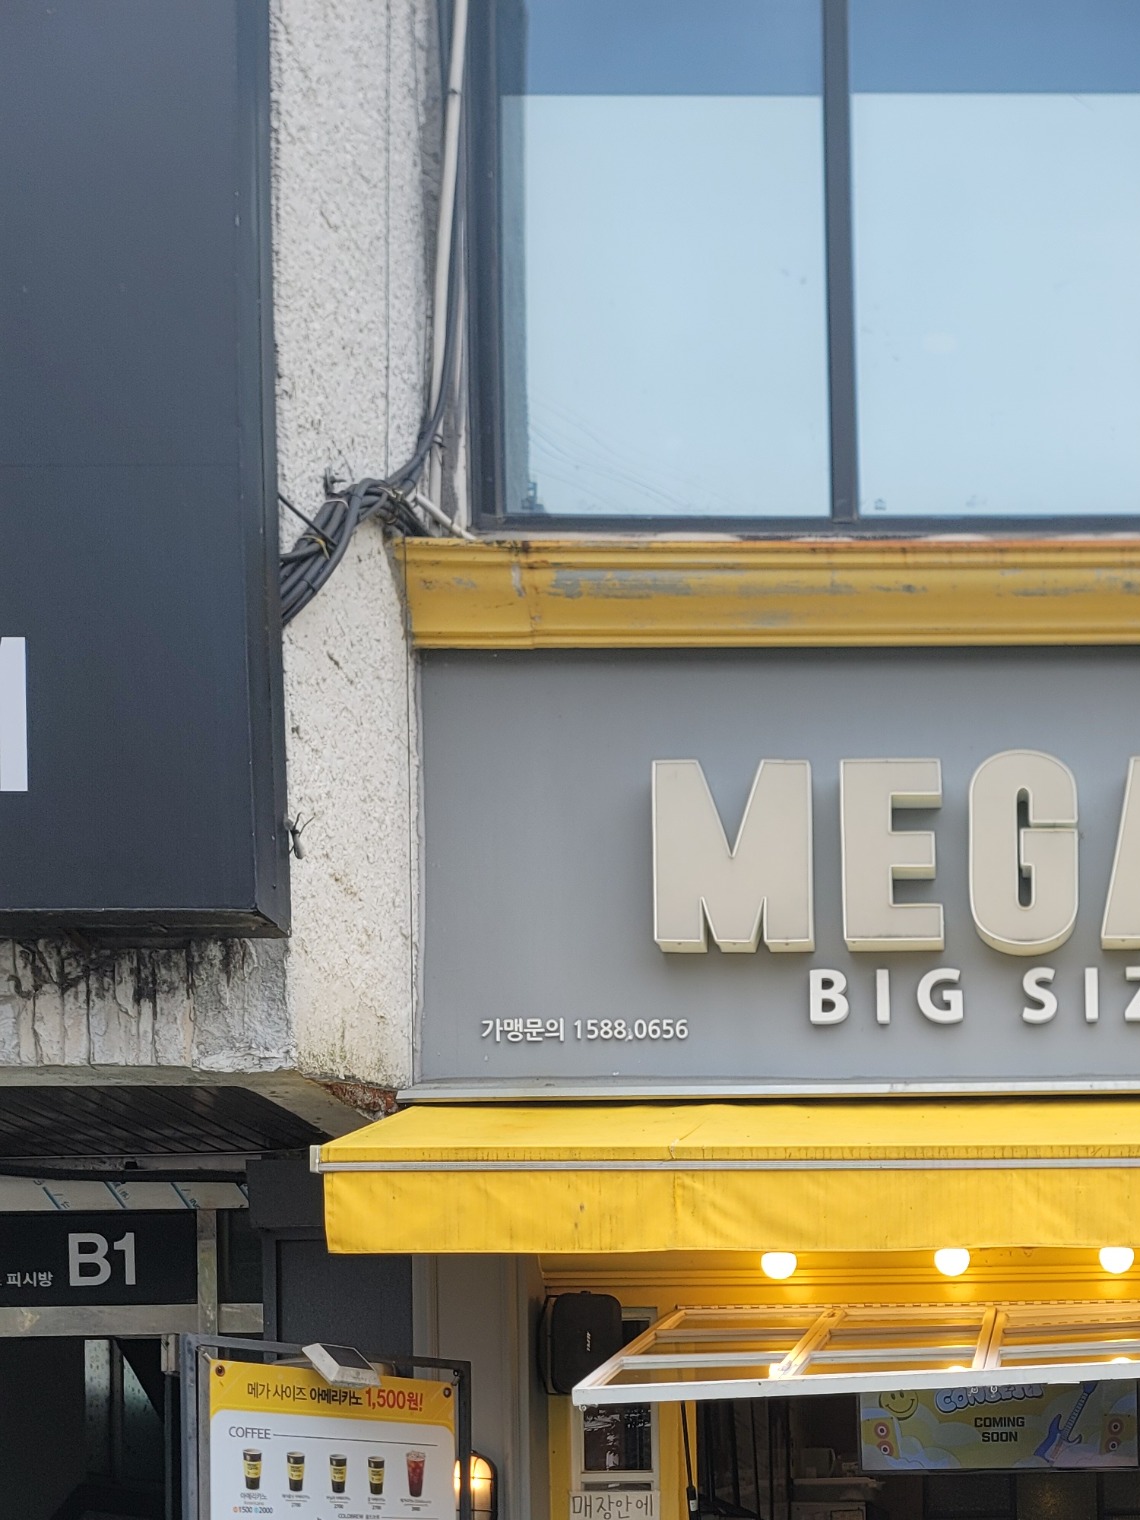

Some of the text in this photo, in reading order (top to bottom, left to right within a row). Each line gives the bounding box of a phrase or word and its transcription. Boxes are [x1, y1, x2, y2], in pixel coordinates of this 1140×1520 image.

[808, 966, 965, 1027] BIG
[481, 1017, 565, 1042] 가맹문의
[67, 1231, 137, 1287] B1
[6, 1271, 54, 1288] 피시방
[248, 1383, 423, 1412] 메가 사이즈 아메리카노 1,500원!
[974, 1416, 1025, 1428] COMING
[228, 1426, 271, 1440] COFFEE
[981, 1431, 1018, 1442] SOON
